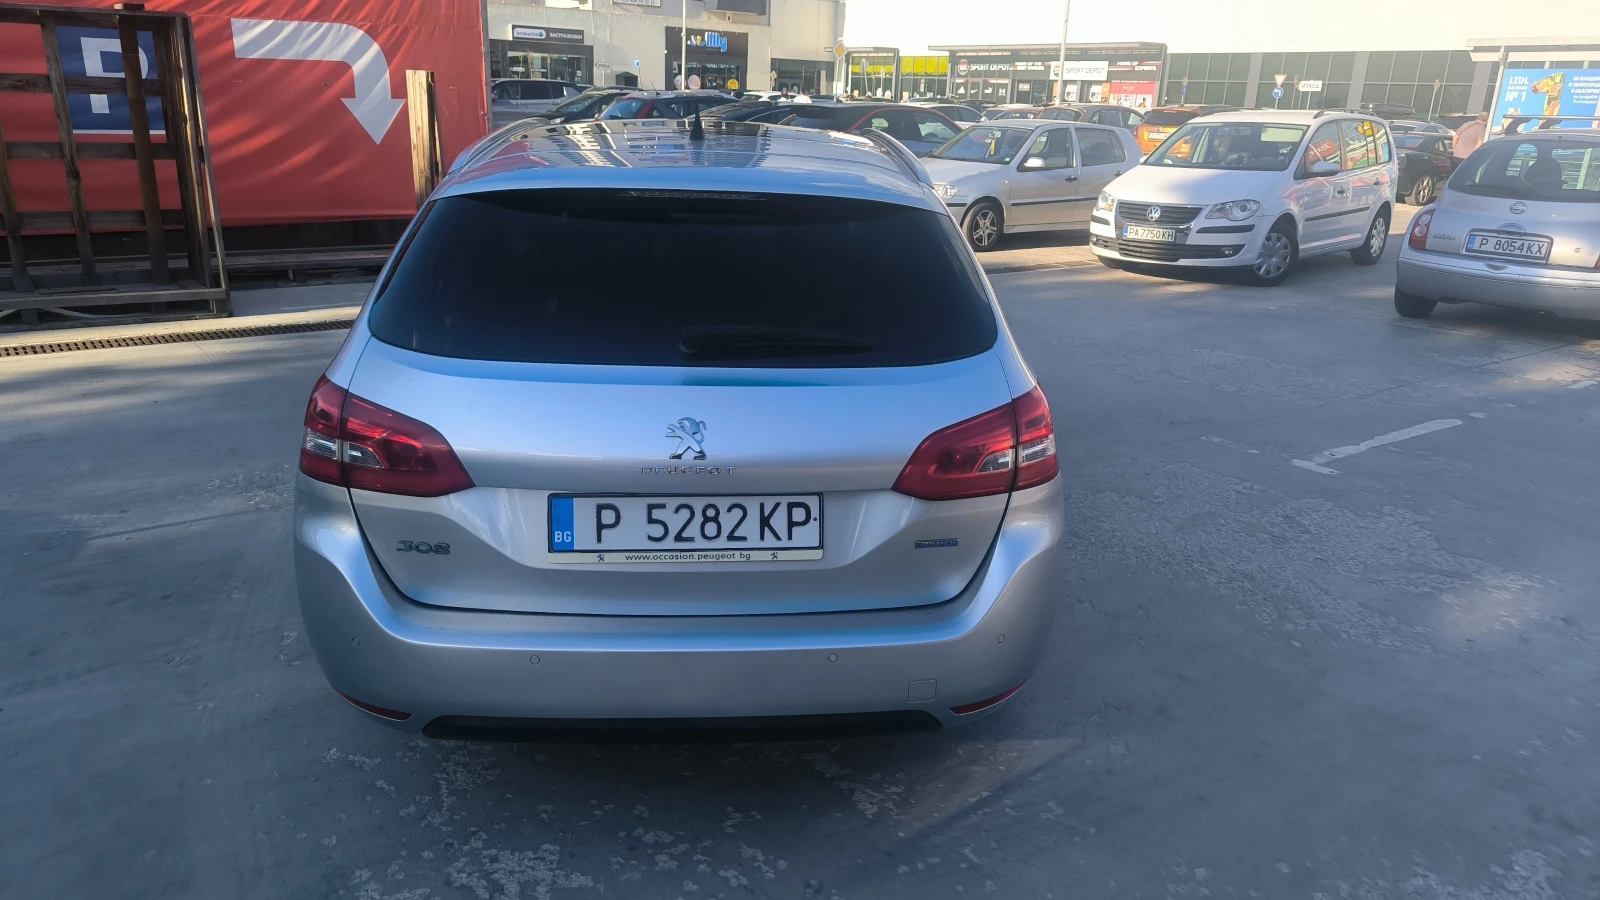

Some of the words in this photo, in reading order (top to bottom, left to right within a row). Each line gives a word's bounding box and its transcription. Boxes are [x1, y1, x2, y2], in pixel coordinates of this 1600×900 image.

[970, 63, 989, 71] SPORT
[990, 63, 1010, 71] DEPOT
[1509, 76, 1529, 85] LIDL
[1520, 90, 1527, 102] 1
[1479, 237, 1489, 249] P
[641, 465, 736, 475] PEUGEOT
[595, 503, 621, 543] P
[554, 531, 572, 543] BG
[395, 540, 451, 555] 308
[625, 552, 751, 562] www.occasion.peugeot.bg
